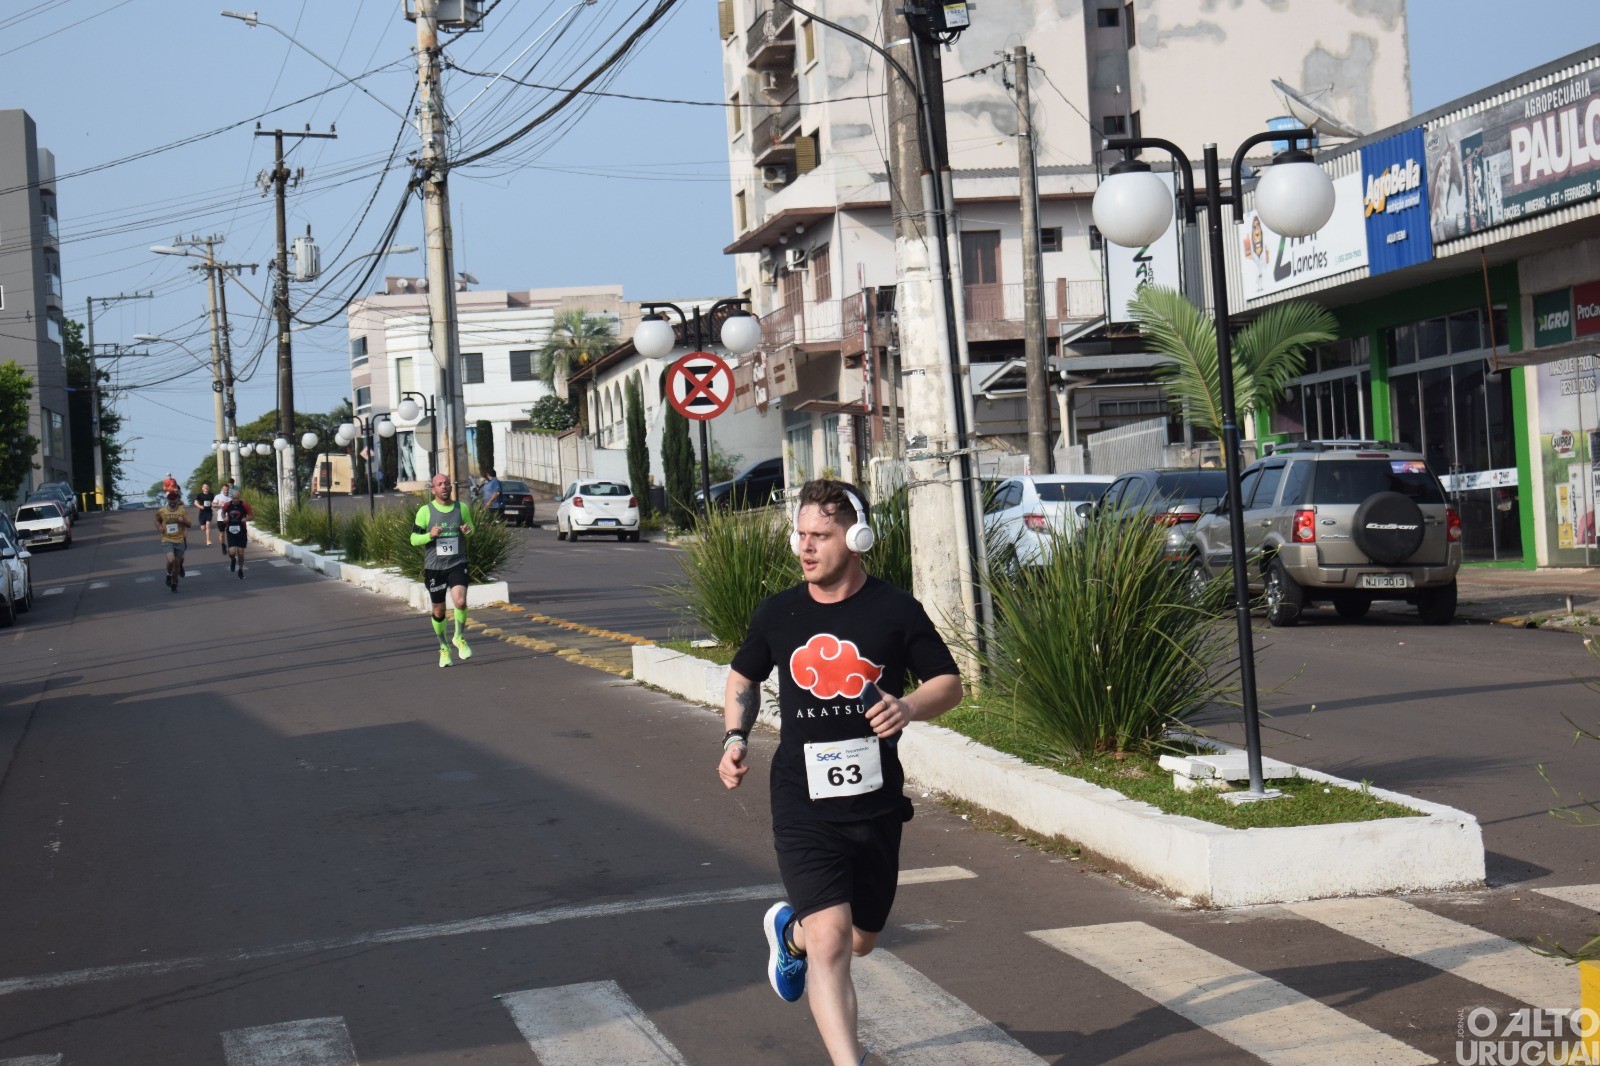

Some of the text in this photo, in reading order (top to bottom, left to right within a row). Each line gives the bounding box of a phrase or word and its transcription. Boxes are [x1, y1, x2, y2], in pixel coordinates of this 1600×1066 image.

[1524, 78, 1591, 119] AGROPECUÁRIA
[1551, 191, 1559, 206] PET
[1564, 182, 1591, 201] FERRAGENS
[1292, 246, 1328, 277] Lanches
[1539, 310, 1570, 332] AGRO
[1553, 436, 1572, 448] SUPRA
[442, 545, 453, 553] 91
[1384, 578, 1405, 587] 3013
[796, 704, 865, 718] AKATSU
[816, 752, 842, 762] sesc
[827, 764, 863, 787] 63
